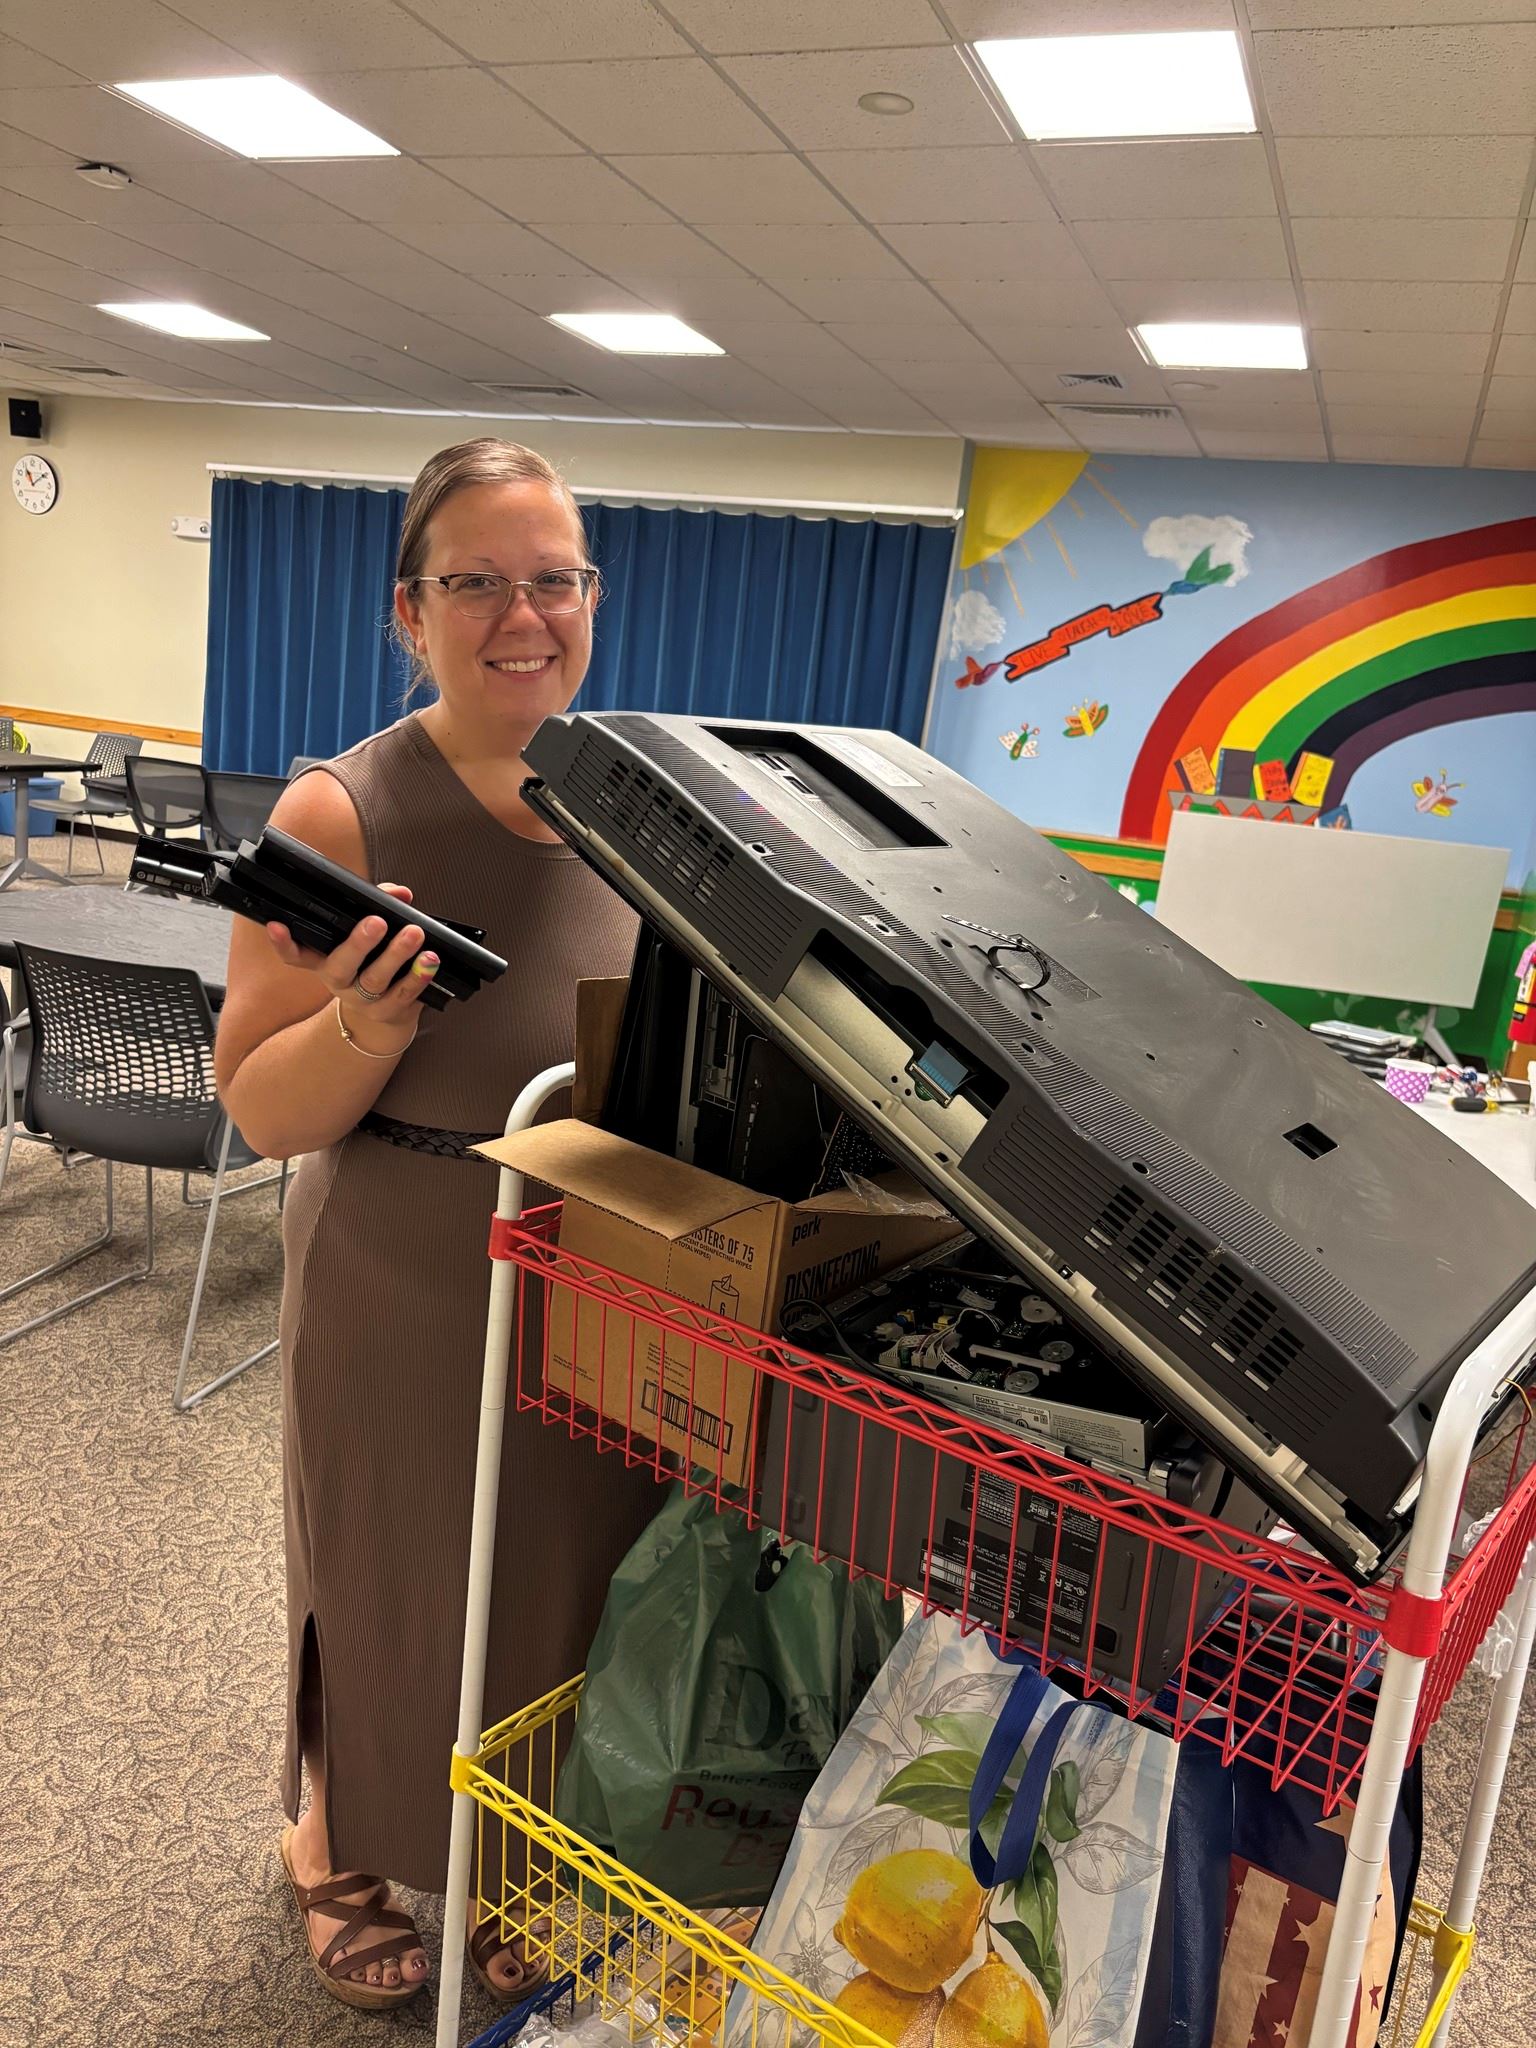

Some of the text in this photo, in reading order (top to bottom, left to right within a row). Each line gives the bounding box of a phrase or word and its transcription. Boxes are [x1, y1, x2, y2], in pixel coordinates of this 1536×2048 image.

[691, 1227, 755, 1263] STERS OF 75
[792, 1215, 821, 1247] perk
[678, 1241, 694, 1253] TOTAL
[700, 1243, 735, 1263] DISINFECTING
[735, 1258, 753, 1271] WIPES
[784, 1240, 881, 1304] DISINFECTING
[719, 1302, 726, 1317] 6
[699, 1769, 753, 1787] Better
